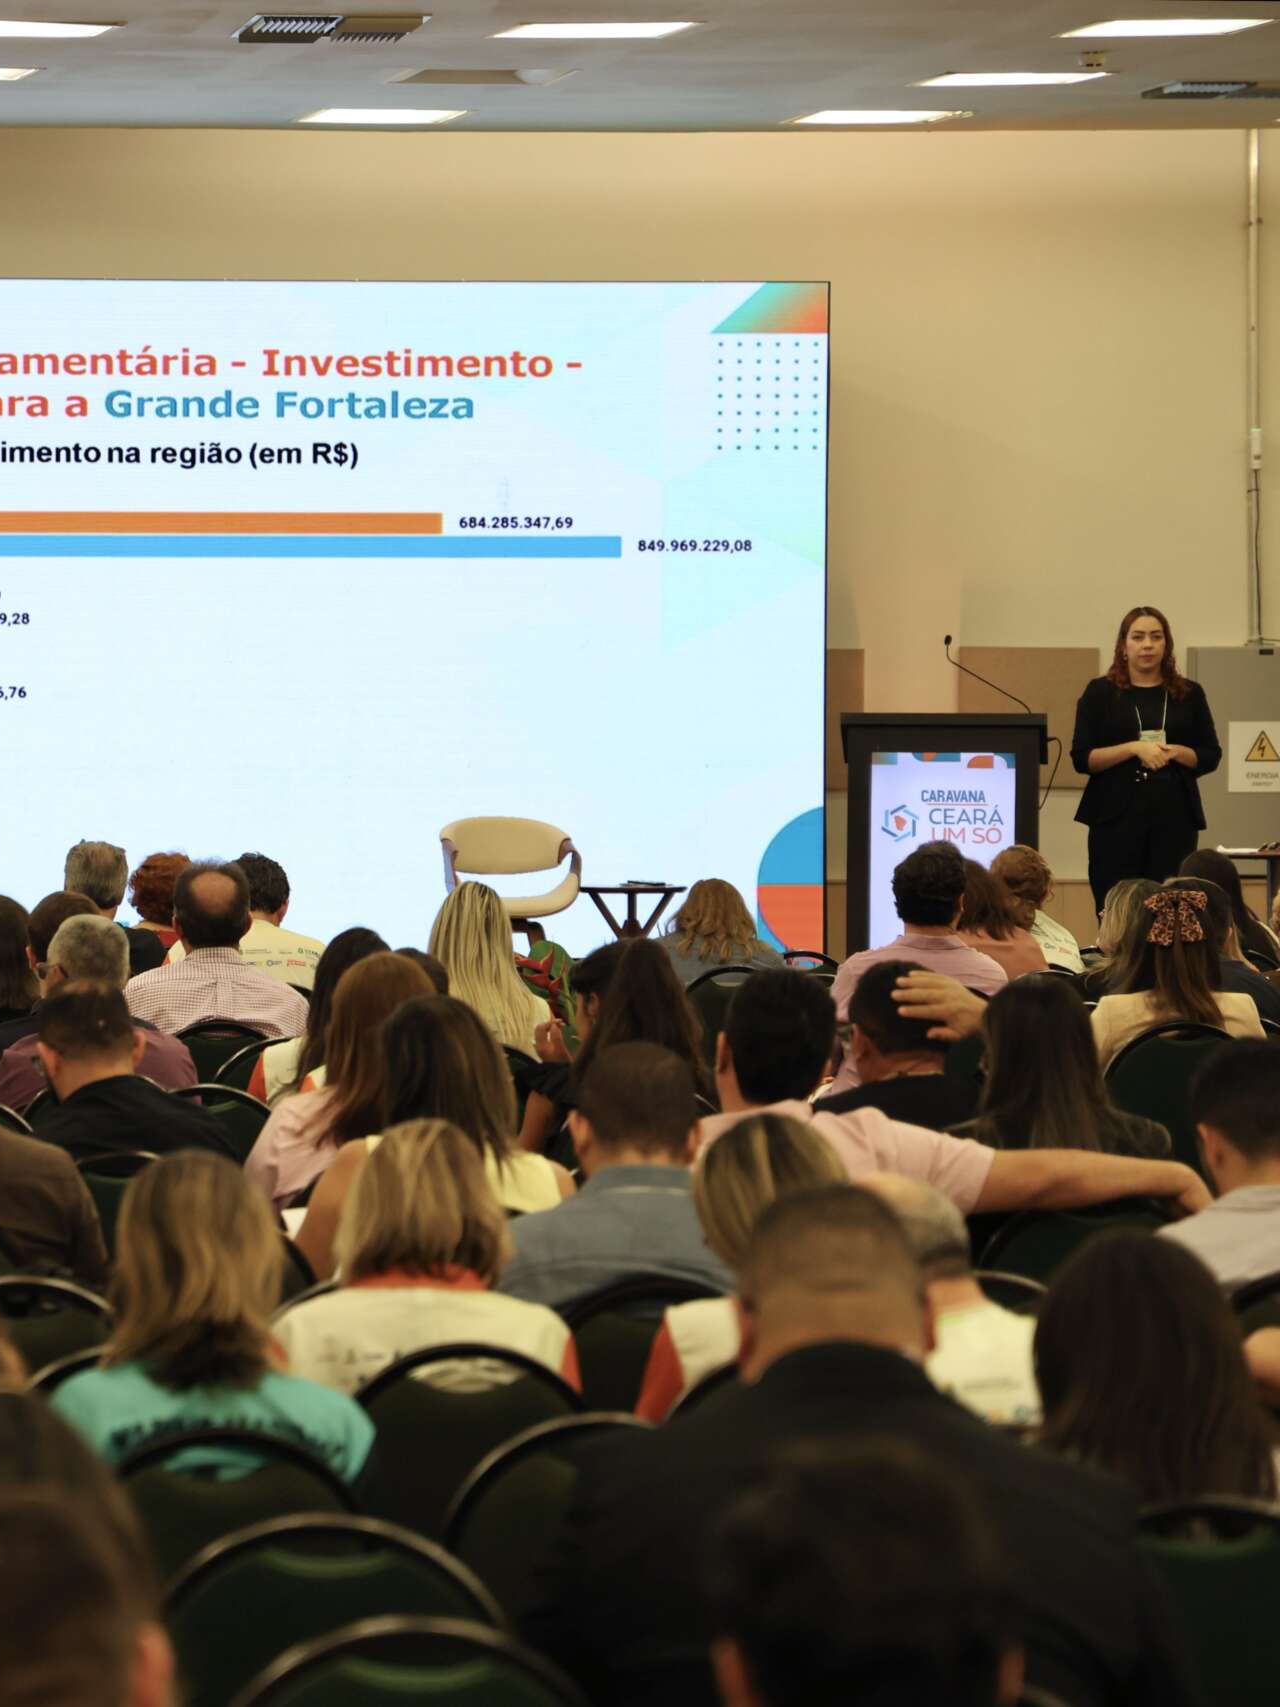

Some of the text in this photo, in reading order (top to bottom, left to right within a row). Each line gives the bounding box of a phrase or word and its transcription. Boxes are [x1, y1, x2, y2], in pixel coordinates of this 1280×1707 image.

[262, 348, 554, 378] Investimento
[64, 395, 89, 418] a
[104, 389, 260, 419] Grande
[275, 389, 474, 420] Fortaleza
[107, 446, 141, 464] na
[150, 441, 243, 470] região
[248, 442, 302, 470] (em
[312, 441, 359, 470] R$)
[458, 516, 574, 531] 684.285.347,69
[637, 539, 753, 554] 849.969.229,08
[921, 789, 986, 803] CARAVANA
[928, 804, 1004, 826] CEARÁ
[931, 823, 1003, 845] UM SÓ
